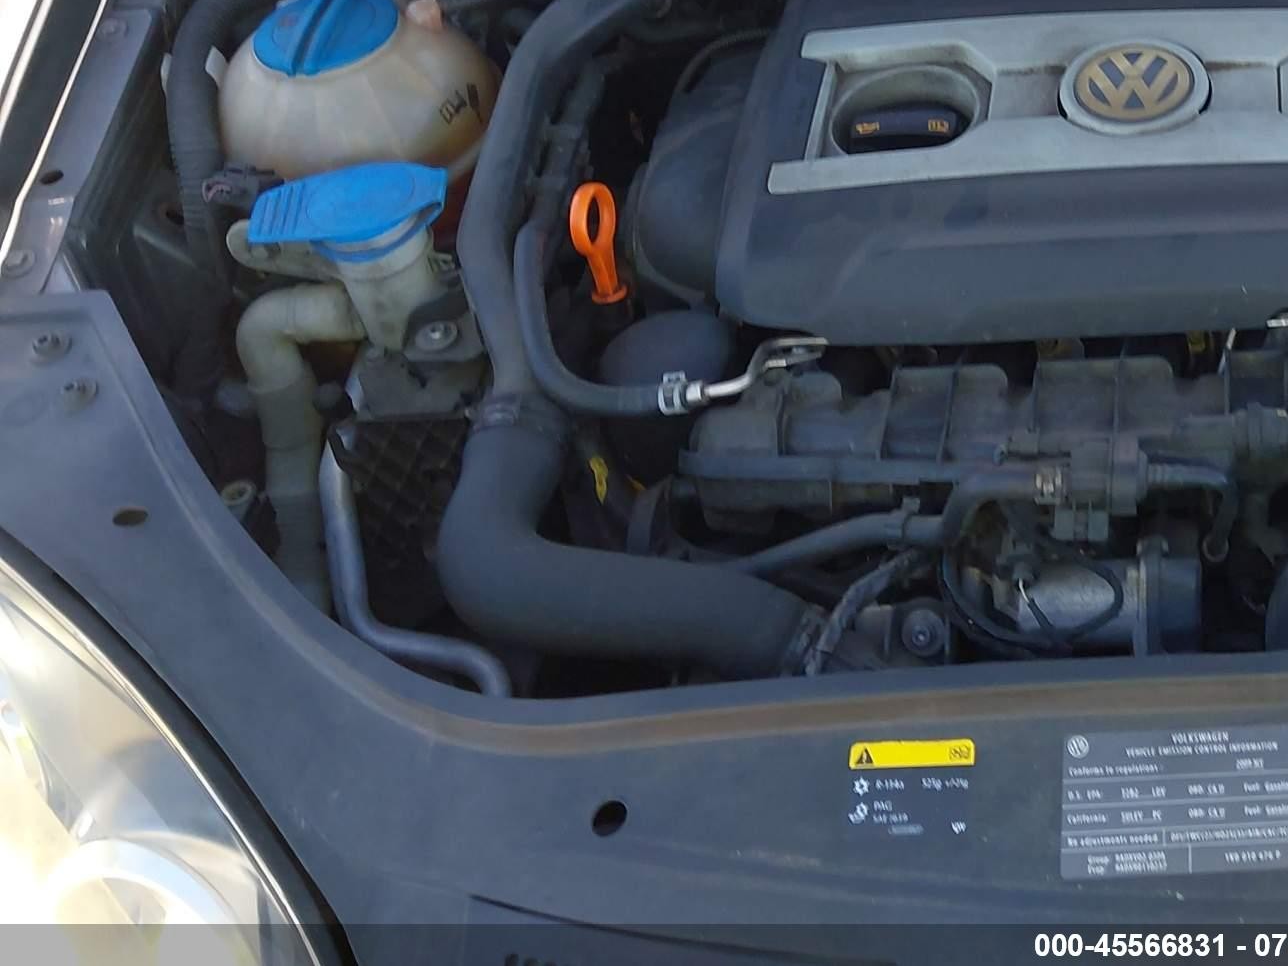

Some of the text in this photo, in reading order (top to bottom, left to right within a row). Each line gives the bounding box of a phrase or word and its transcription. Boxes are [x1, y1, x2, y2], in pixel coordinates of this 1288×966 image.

[1171, 731, 1229, 744] VOLKSWAGEN
[1125, 740, 1279, 757] VEHICLE EMISSION CONTROL INFORMATION
